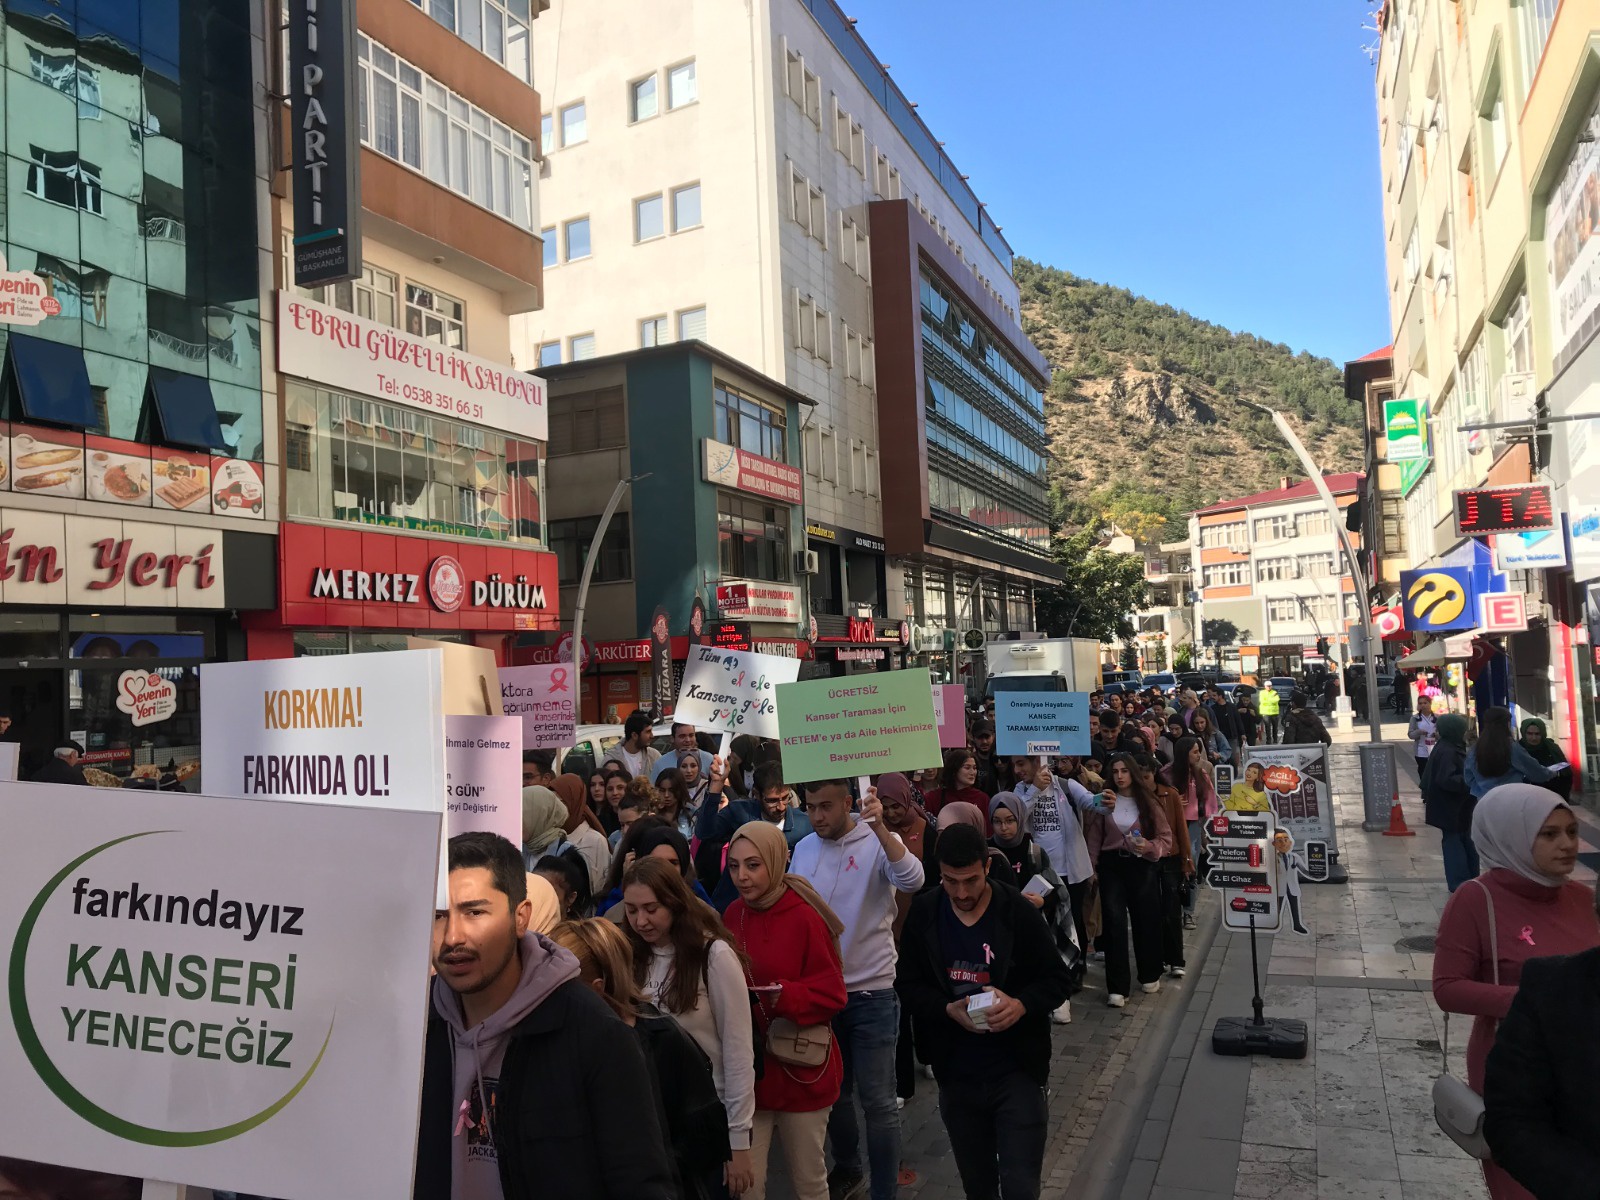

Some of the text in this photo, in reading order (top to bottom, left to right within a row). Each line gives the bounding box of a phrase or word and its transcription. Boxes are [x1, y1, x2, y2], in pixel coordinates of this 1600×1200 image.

[303, 63, 328, 226] PARTİ
[288, 302, 542, 406] EBRU GÜZELLİK SALONU
[377, 374, 483, 419] Tel: 0538 351 66 51
[87, 538, 215, 590] Yeri
[313, 567, 548, 609] MERKEZ DÜRÜM
[725, 586, 739, 599] 1.
[718, 597, 747, 606] NOTER
[1493, 600, 1518, 625] E
[698, 648, 721, 664] Tüm
[123, 676, 172, 706] Sevenin
[501, 682, 533, 697] ktora
[685, 684, 738, 705] Kansere
[828, 684, 880, 699] ÜCRETSİZ
[136, 703, 156, 720] Yeri
[264, 687, 363, 730] KORKMA!
[805, 703, 906, 722] Kanser Taraması İçin
[1044, 701, 1074, 709] Hayatınız
[830, 734, 842, 743] ya
[844, 730, 857, 739] da
[858, 729, 878, 739] Aile
[879, 722, 934, 736] Hekiminize
[477, 739, 511, 749] Gelmez
[1033, 745, 1060, 753] KETEM
[829, 747, 892, 763] Başvurunuz!
[243, 754, 390, 797] FARKINDA OL!
[1269, 771, 1293, 780] ACİL!
[463, 803, 498, 813] Değiştirir
[1218, 848, 1247, 856] Telefon
[1214, 874, 1222, 882] 2.
[1230, 875, 1252, 883] Cihaz
[72, 878, 305, 942] farkındayız
[66, 943, 297, 1010] KANSERİ
[962, 972, 971, 980] DO
[60, 1006, 294, 1068] YENECEĞİZ
[468, 1146, 498, 1158] JACK&
